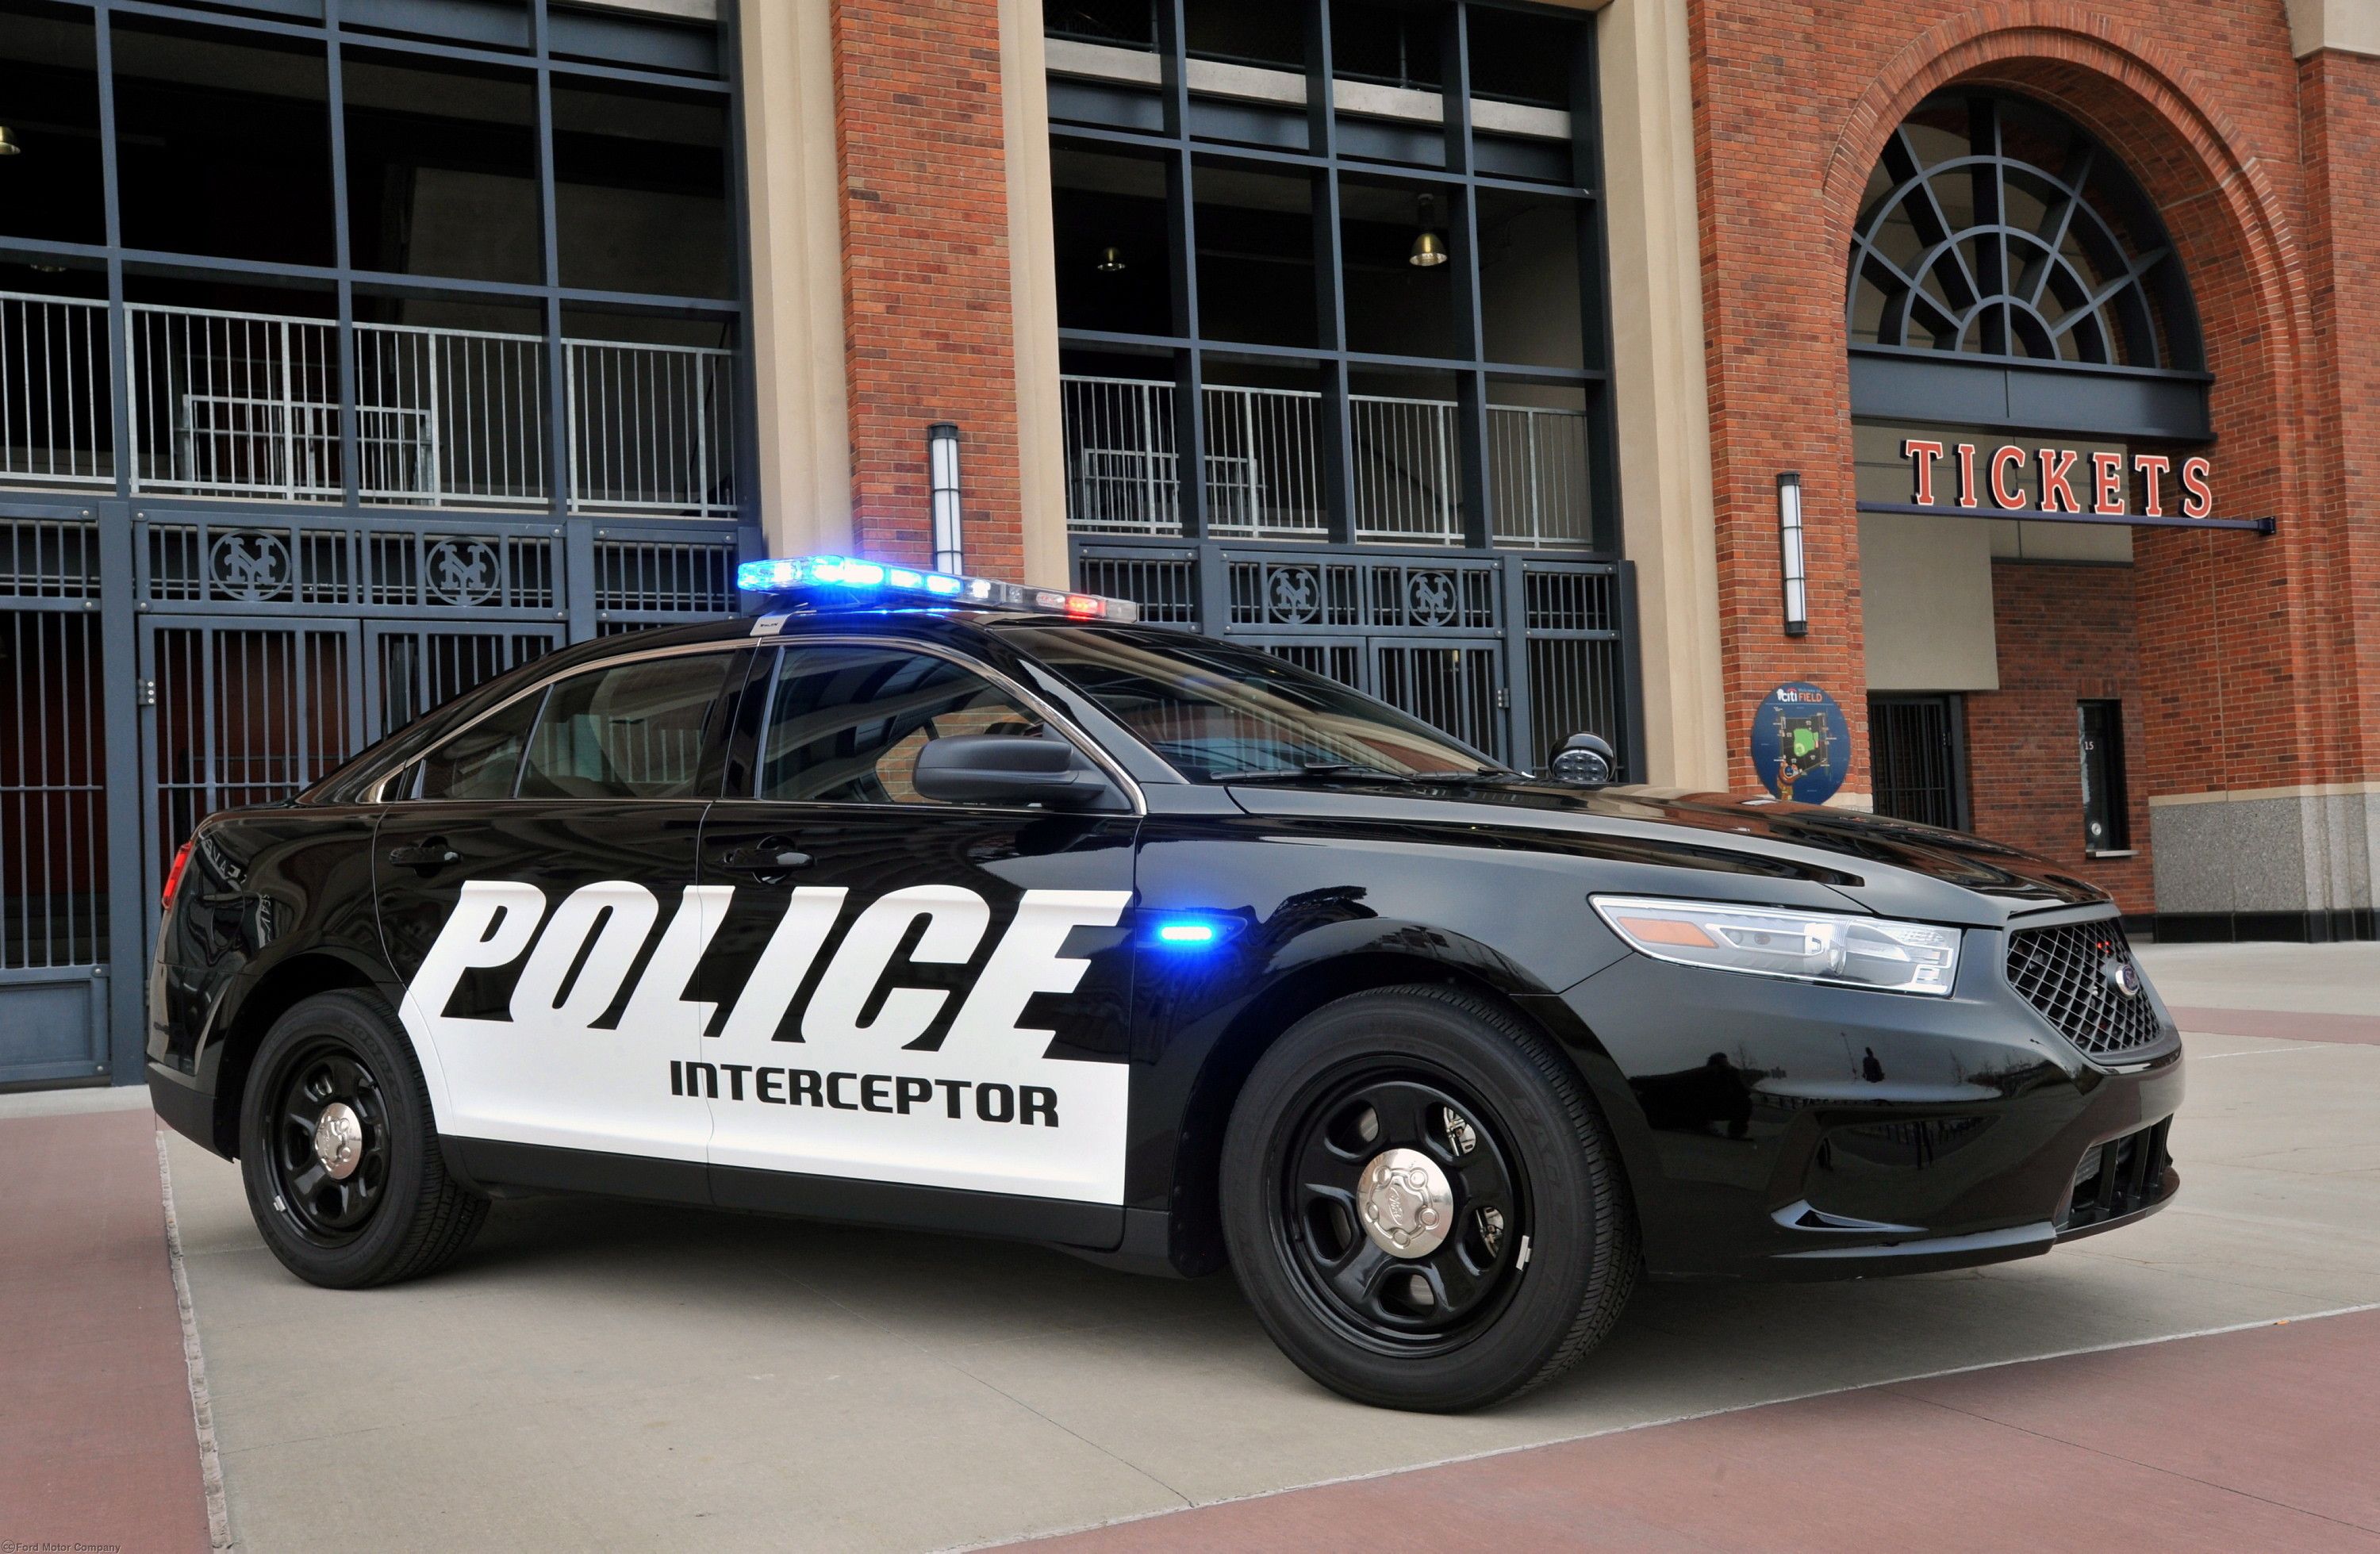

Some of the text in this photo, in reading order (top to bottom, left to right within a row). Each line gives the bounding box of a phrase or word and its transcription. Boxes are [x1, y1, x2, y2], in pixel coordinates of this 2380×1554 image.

[1904, 440, 2212, 519] TICKETS
[1799, 693, 1822, 702] FIELD
[2085, 741, 2094, 750] 15
[401, 880, 1132, 1059] POLICE
[670, 1061, 1058, 1129] INTERCEPTOR
